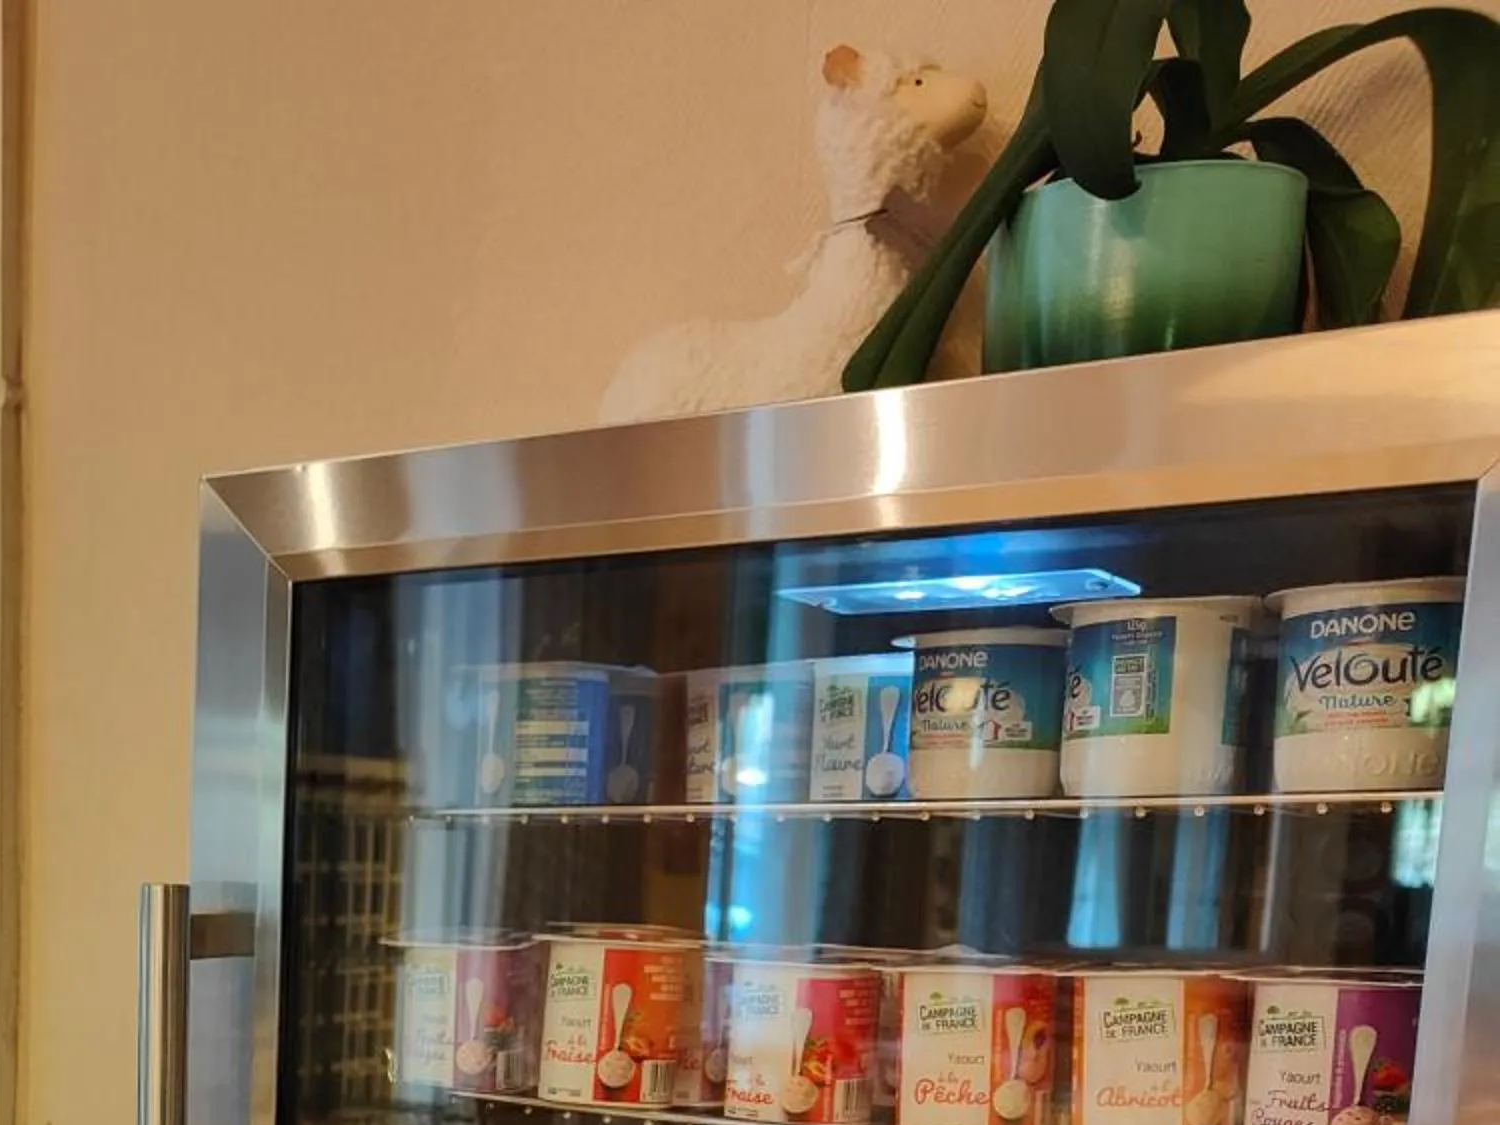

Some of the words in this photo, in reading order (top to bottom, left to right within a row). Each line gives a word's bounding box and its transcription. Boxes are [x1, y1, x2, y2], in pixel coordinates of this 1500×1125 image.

[1311, 611, 1416, 639] DANONE
[920, 650, 988, 671] DANONE
[1290, 647, 1444, 692] Velouté
[919, 1004, 977, 1021] CAMPAGNE
[1103, 1010, 1167, 1029] CAMPAGNE
[935, 1016, 977, 1030] FRANCE
[1121, 1024, 1168, 1037] FRANCE
[1258, 1018, 1318, 1037] CAMPAGNE
[1271, 1033, 1317, 1047] FRANCE
[914, 1078, 989, 1105] Pêche
[1095, 1083, 1185, 1107] Abricot
[1267, 1089, 1329, 1112] Fruits
